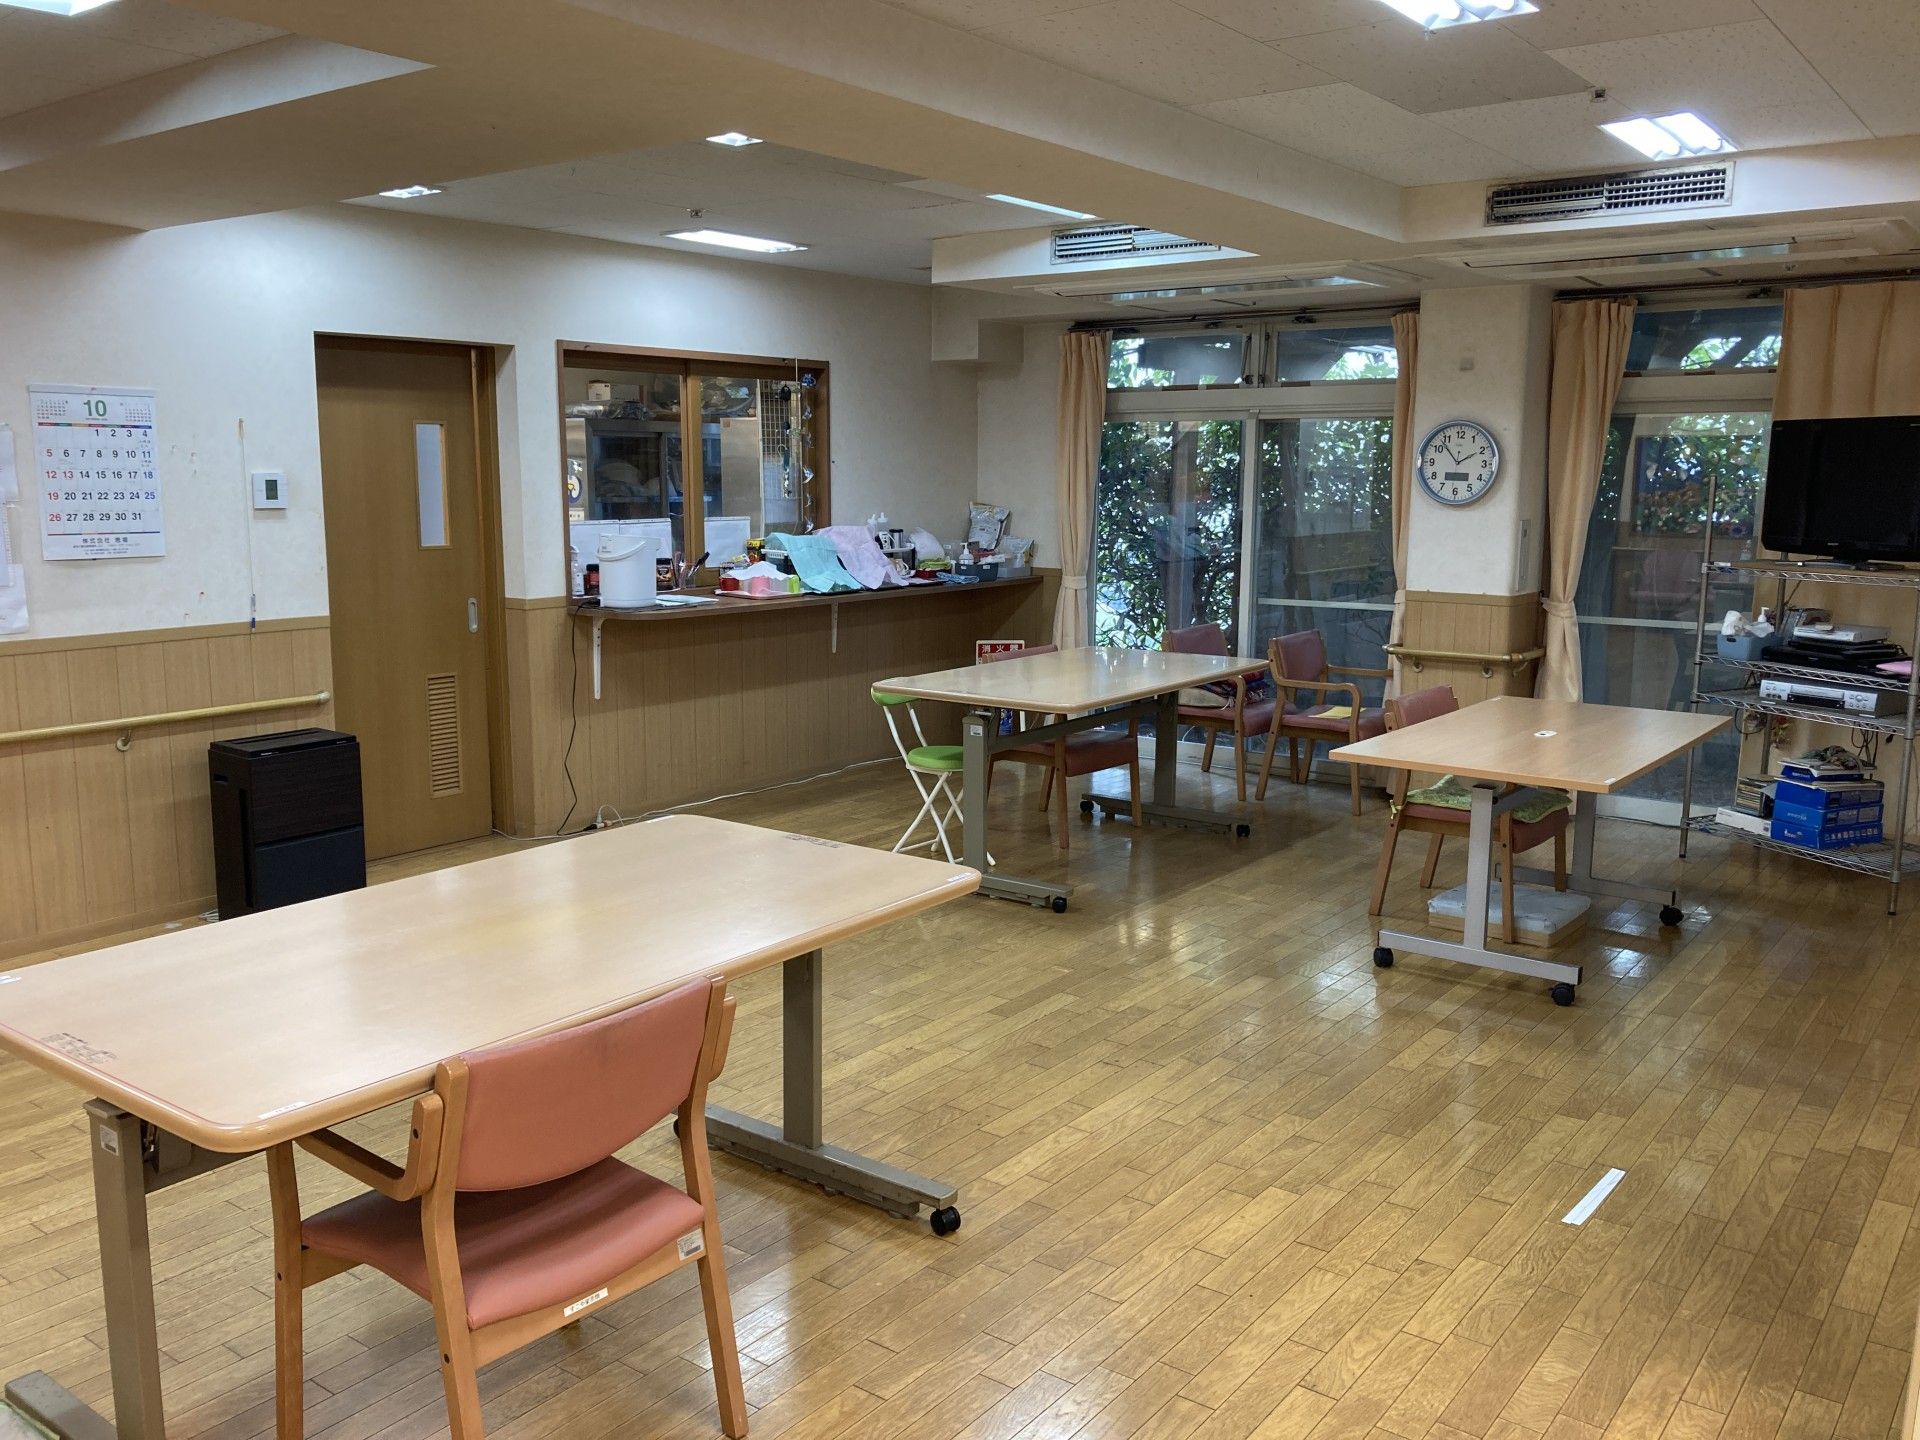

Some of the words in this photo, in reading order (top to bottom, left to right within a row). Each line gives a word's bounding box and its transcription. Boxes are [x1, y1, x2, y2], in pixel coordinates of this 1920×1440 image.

[83, 400, 107, 417] 10
[110, 429, 116, 437] 2
[1457, 431, 1465, 439] 12
[1443, 435, 1451, 443] 11
[1472, 435, 1476, 443] 1
[1434, 445, 1443, 453] 10
[47, 449, 53, 457] 5
[96, 450, 102, 458] 8
[112, 450, 118, 458] 9
[1429, 458, 1435, 466] 9
[1481, 460, 1487, 468] 3
[46, 471, 57, 479] 12
[63, 471, 74, 479] 13
[80, 471, 90, 479] 14
[96, 471, 106, 479] 15
[112, 471, 122, 479] 16
[128, 471, 138, 479] 17
[143, 471, 153, 479] 18
[1431, 472, 1437, 480] 8
[1440, 482, 1446, 490] 7
[1467, 484, 1472, 492] 5
[48, 492, 59, 500] 19
[64, 492, 76, 500] 20
[82, 492, 92, 500] 21
[97, 492, 108, 500] 22
[114, 492, 125, 500] 23
[129, 492, 140, 500] 24
[49, 514, 62, 522] 26
[83, 513, 95, 521] 28
[99, 513, 111, 521] 29
[982, 644, 1018, 653] 消火器
